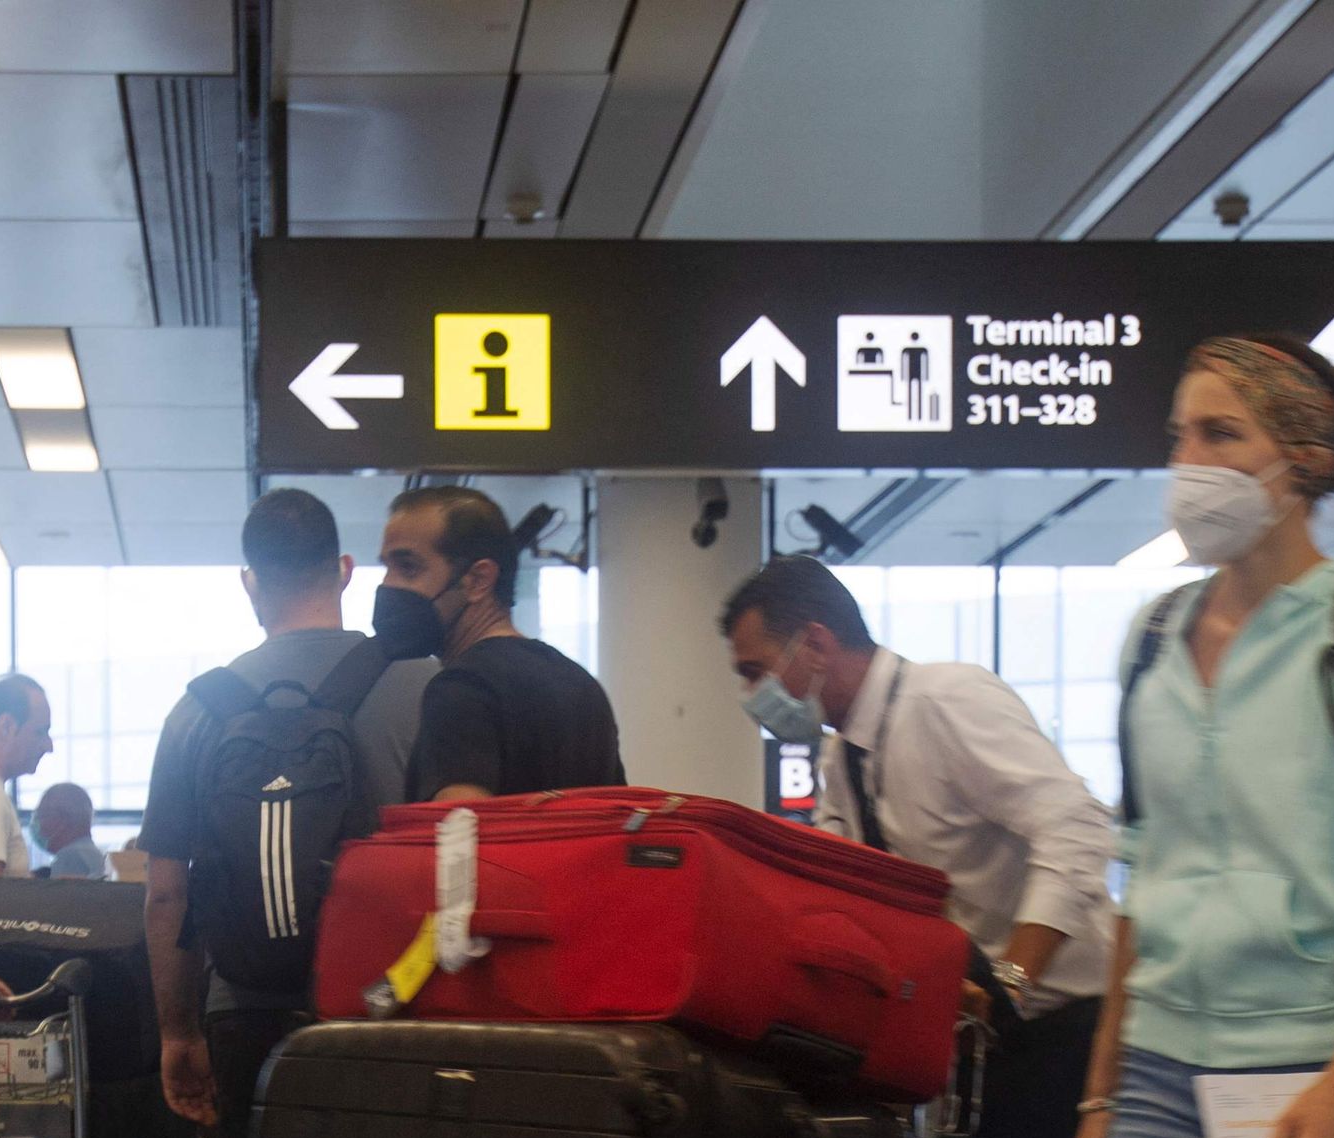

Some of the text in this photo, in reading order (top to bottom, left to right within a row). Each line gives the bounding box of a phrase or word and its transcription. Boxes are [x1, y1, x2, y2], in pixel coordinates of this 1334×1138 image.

[966, 312, 1141, 346] Terminal 3
[966, 352, 1112, 386] Check-in
[966, 394, 1097, 426] 311–328
[779, 757, 815, 798] B
